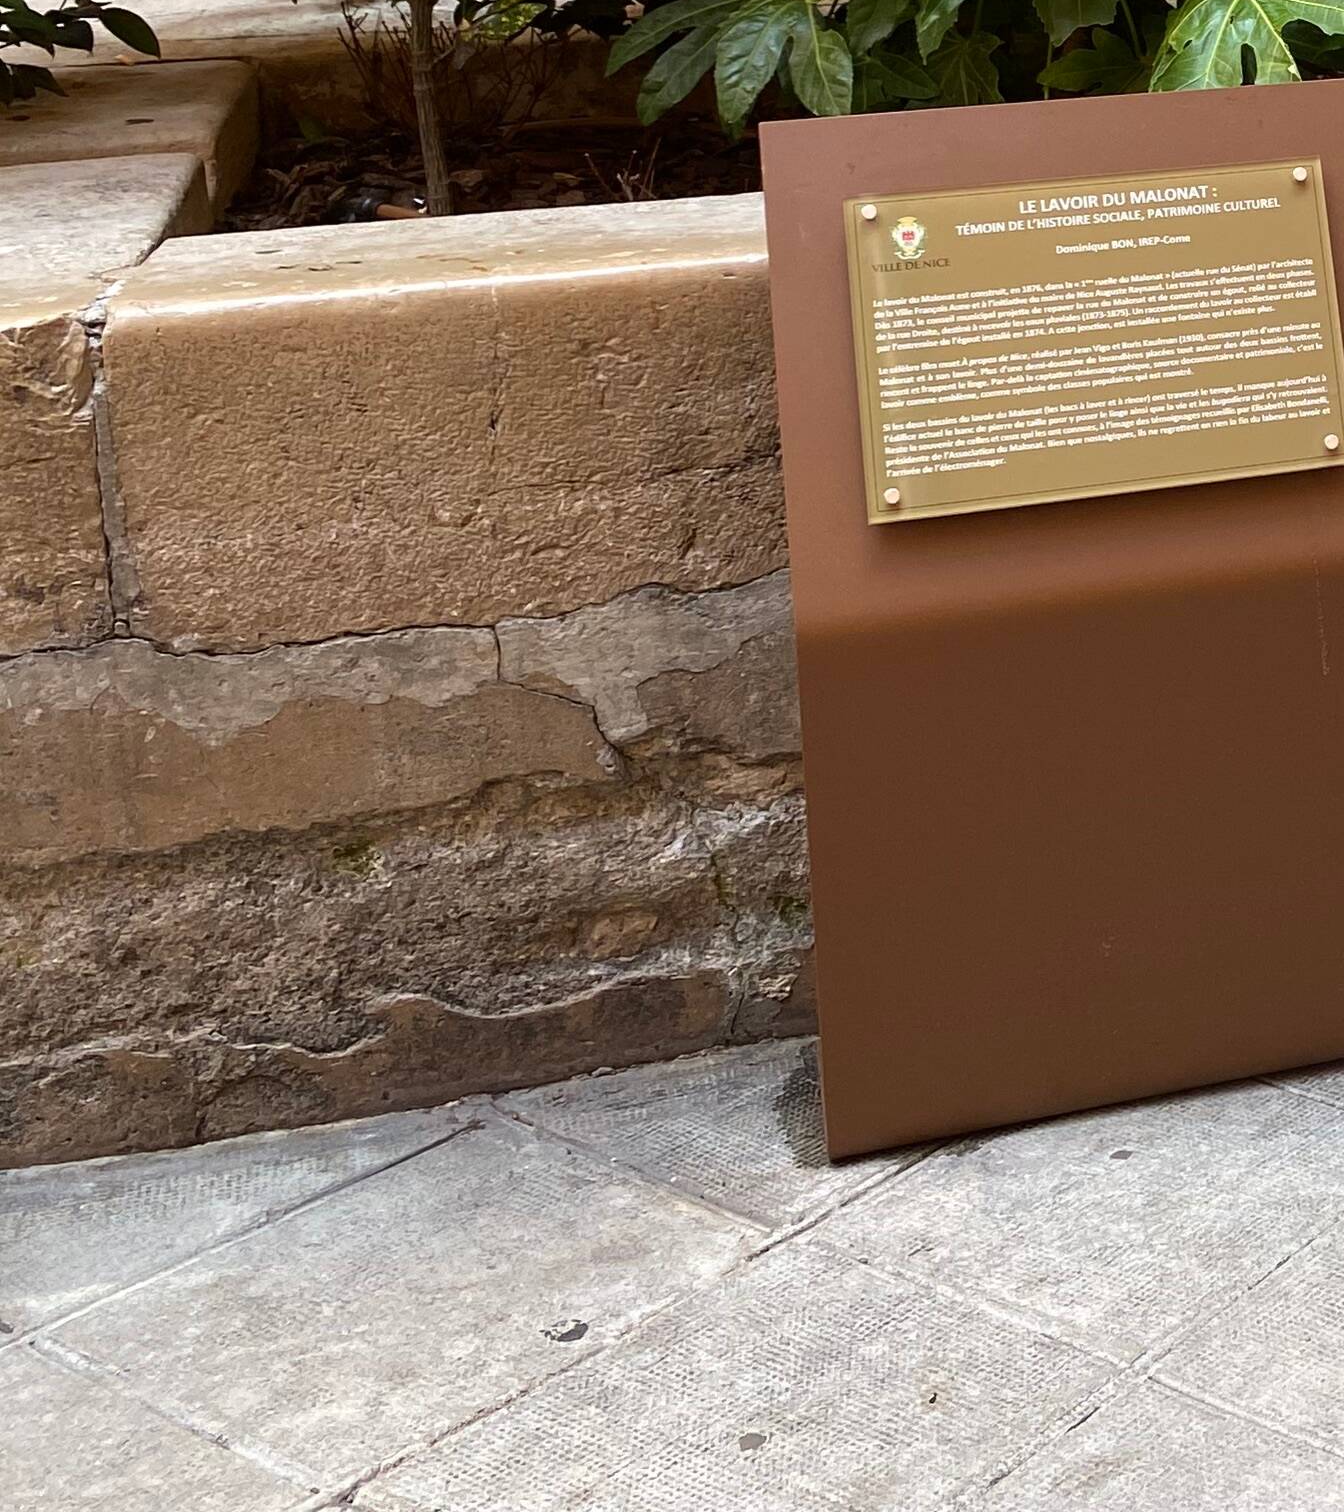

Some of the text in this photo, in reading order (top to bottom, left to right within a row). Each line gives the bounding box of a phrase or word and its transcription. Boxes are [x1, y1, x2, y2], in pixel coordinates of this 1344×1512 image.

[1020, 200, 1038, 214] LE
[1041, 195, 1099, 212] LAVOIR
[1102, 192, 1126, 207] DU
[1130, 185, 1208, 205] MALONAT
[955, 198, 1281, 236] TÉMOIN DE L'HISTOIRE SOCIALE, PATRIMOINE CULTUREL
[1056, 242, 1110, 254] Dominique
[1112, 239, 1137, 249] BON,
[872, 258, 951, 274] VILLE DE NICE
